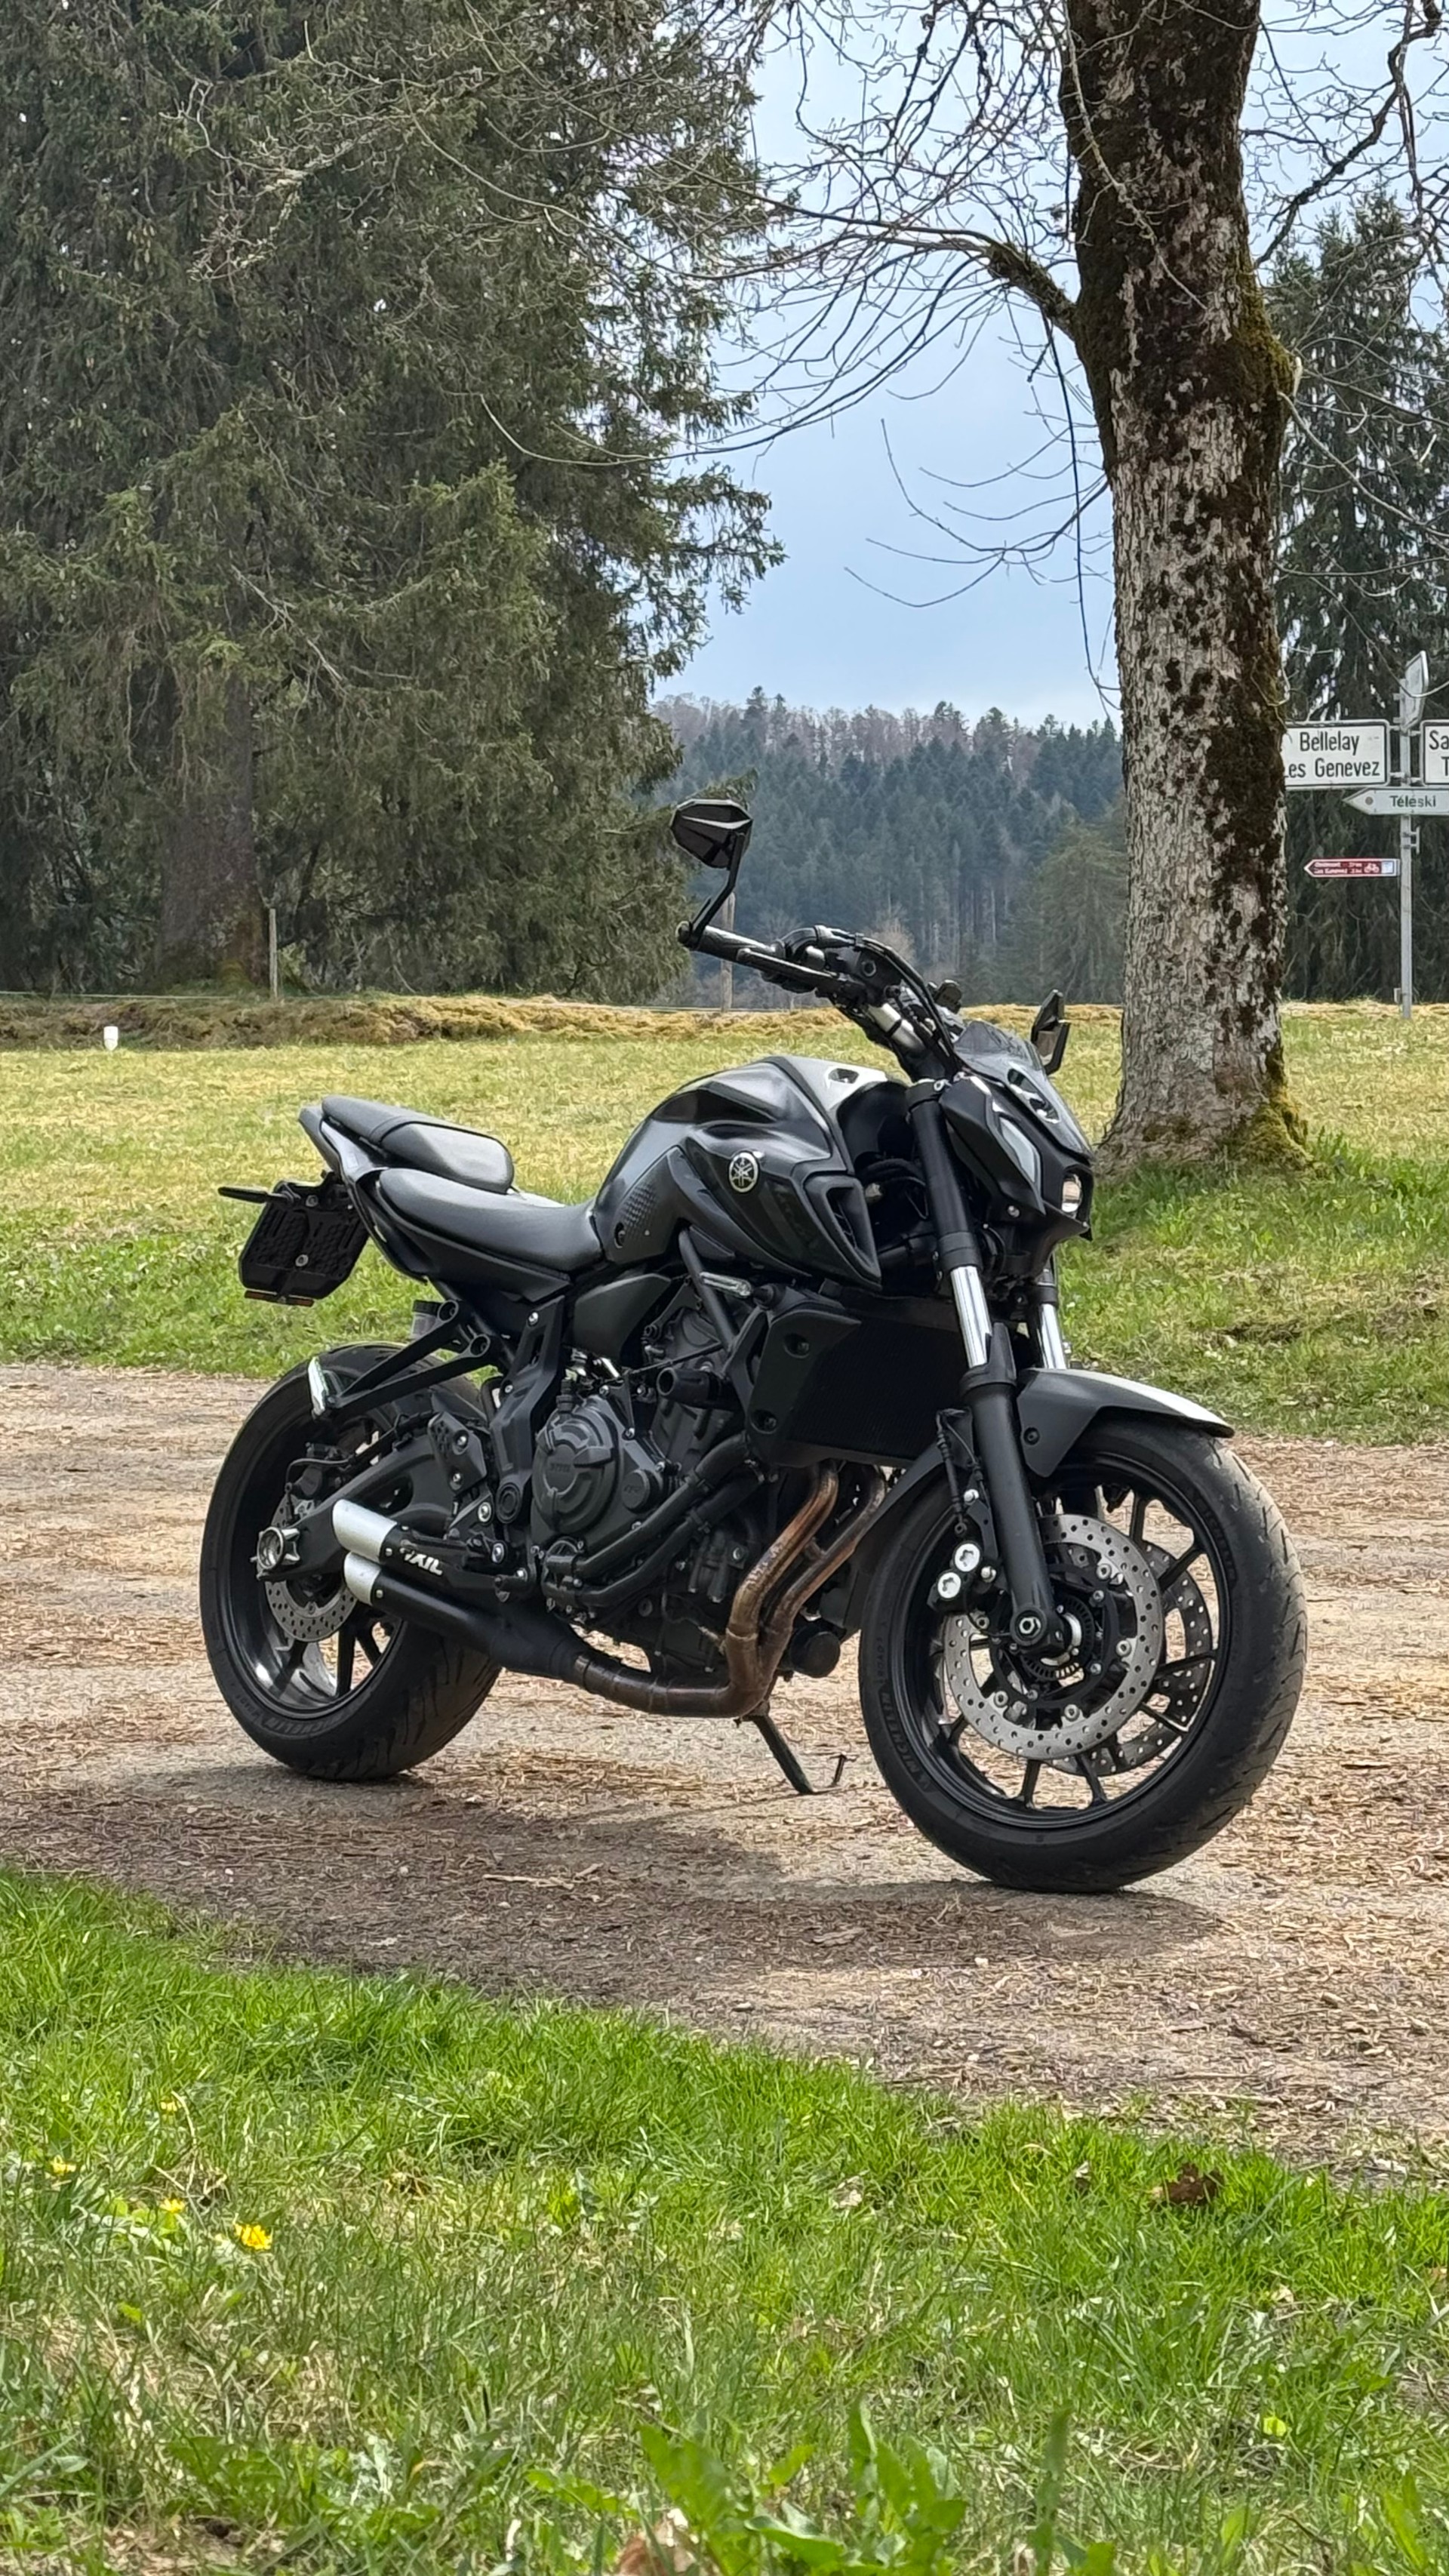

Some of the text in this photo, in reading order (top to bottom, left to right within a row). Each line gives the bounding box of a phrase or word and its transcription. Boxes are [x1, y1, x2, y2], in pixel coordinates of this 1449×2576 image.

[1300, 731, 1360, 756] Bellelay
[1315, 758, 1380, 778] Genevez
[881, 1692, 921, 1774] MICHELIN
